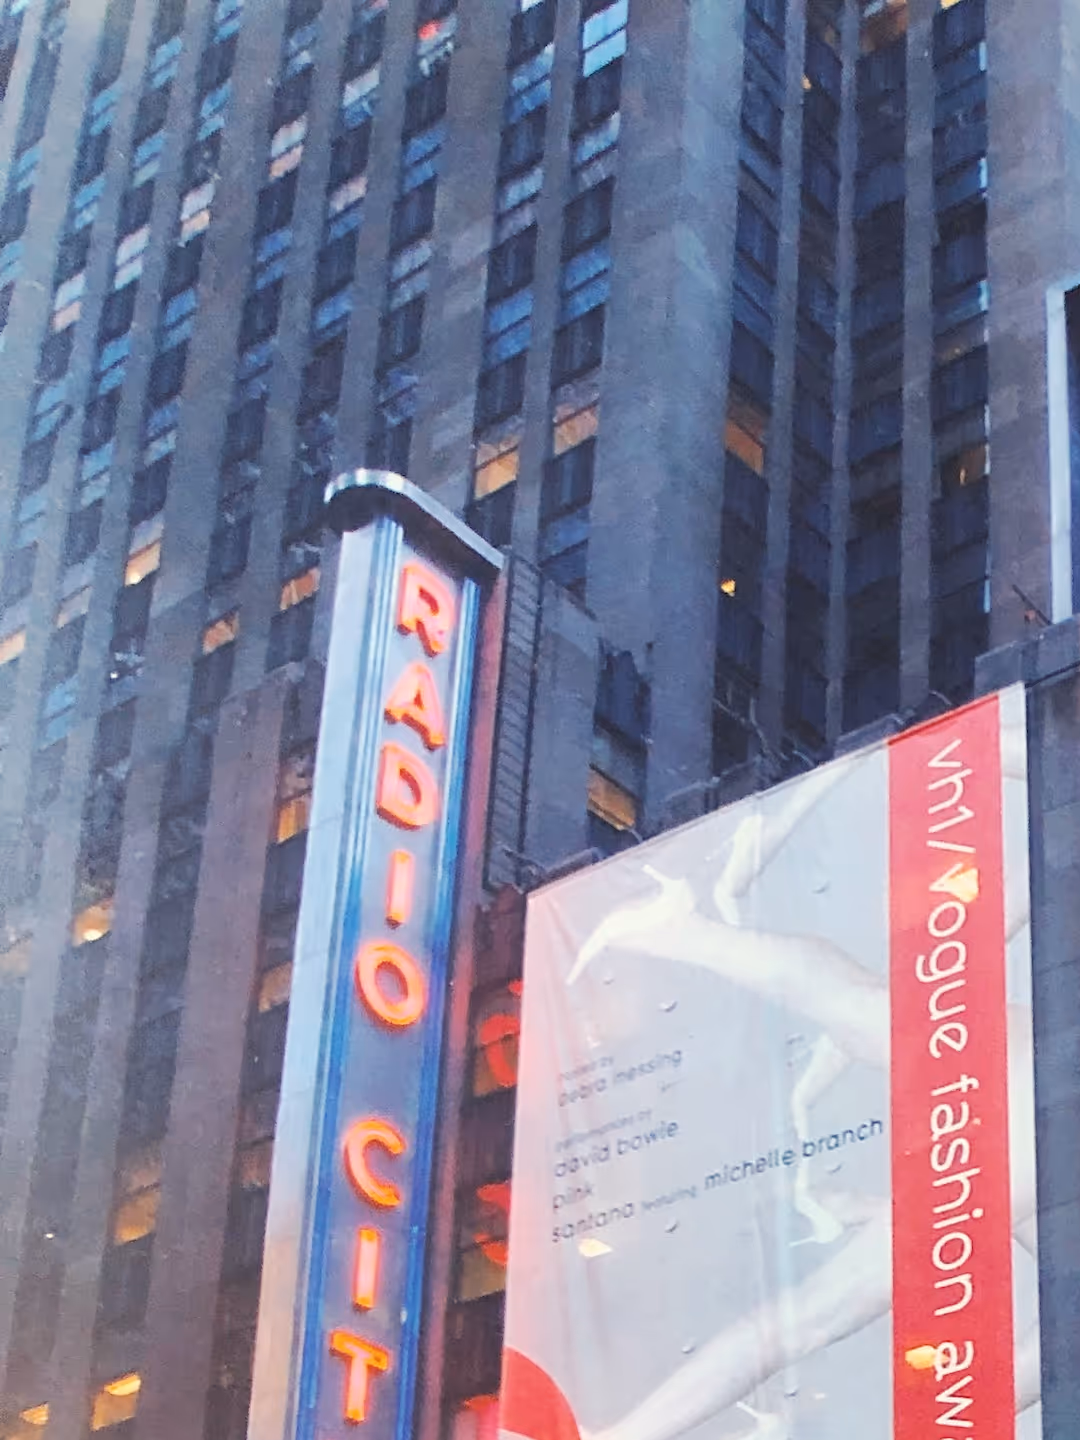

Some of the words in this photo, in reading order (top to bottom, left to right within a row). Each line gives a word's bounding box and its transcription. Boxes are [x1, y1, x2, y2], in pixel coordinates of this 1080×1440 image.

[355, 561, 456, 1030] RADIO
[704, 1147, 797, 1191] michelle
[801, 1117, 884, 1158] branch
[930, 1075, 985, 1317] fashion
